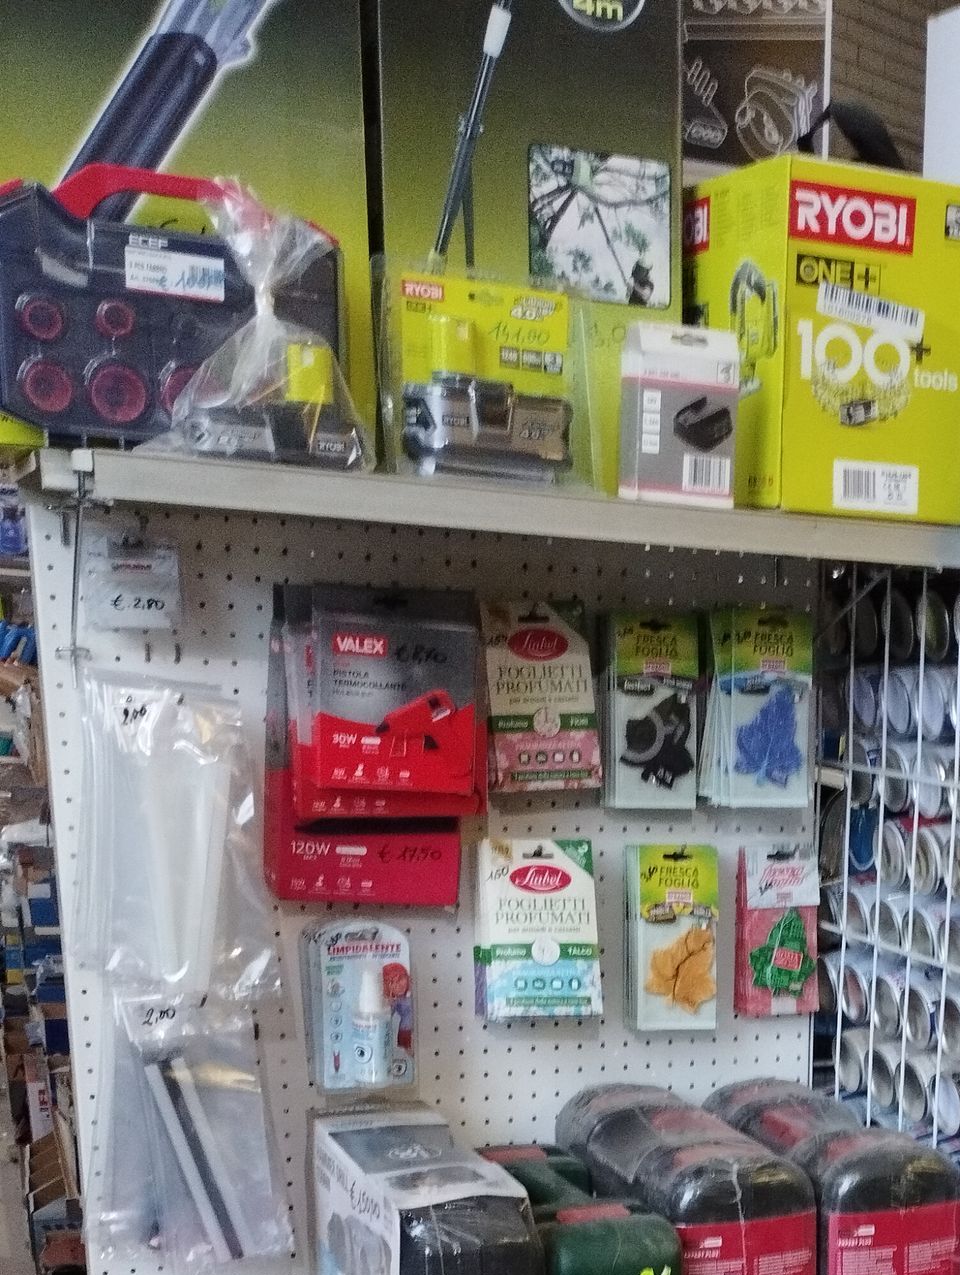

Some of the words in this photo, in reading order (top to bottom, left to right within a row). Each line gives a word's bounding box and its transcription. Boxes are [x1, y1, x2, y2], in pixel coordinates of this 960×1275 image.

[795, 189, 911, 247] RYOBI
[404, 284, 443, 300] RYOBI
[913, 368, 958, 393] tools
[335, 635, 385, 655] VALEX
[290, 839, 332, 857] 120W
[498, 896, 586, 911] FOGLIETTI
[495, 911, 591, 926] PROFUMATI
